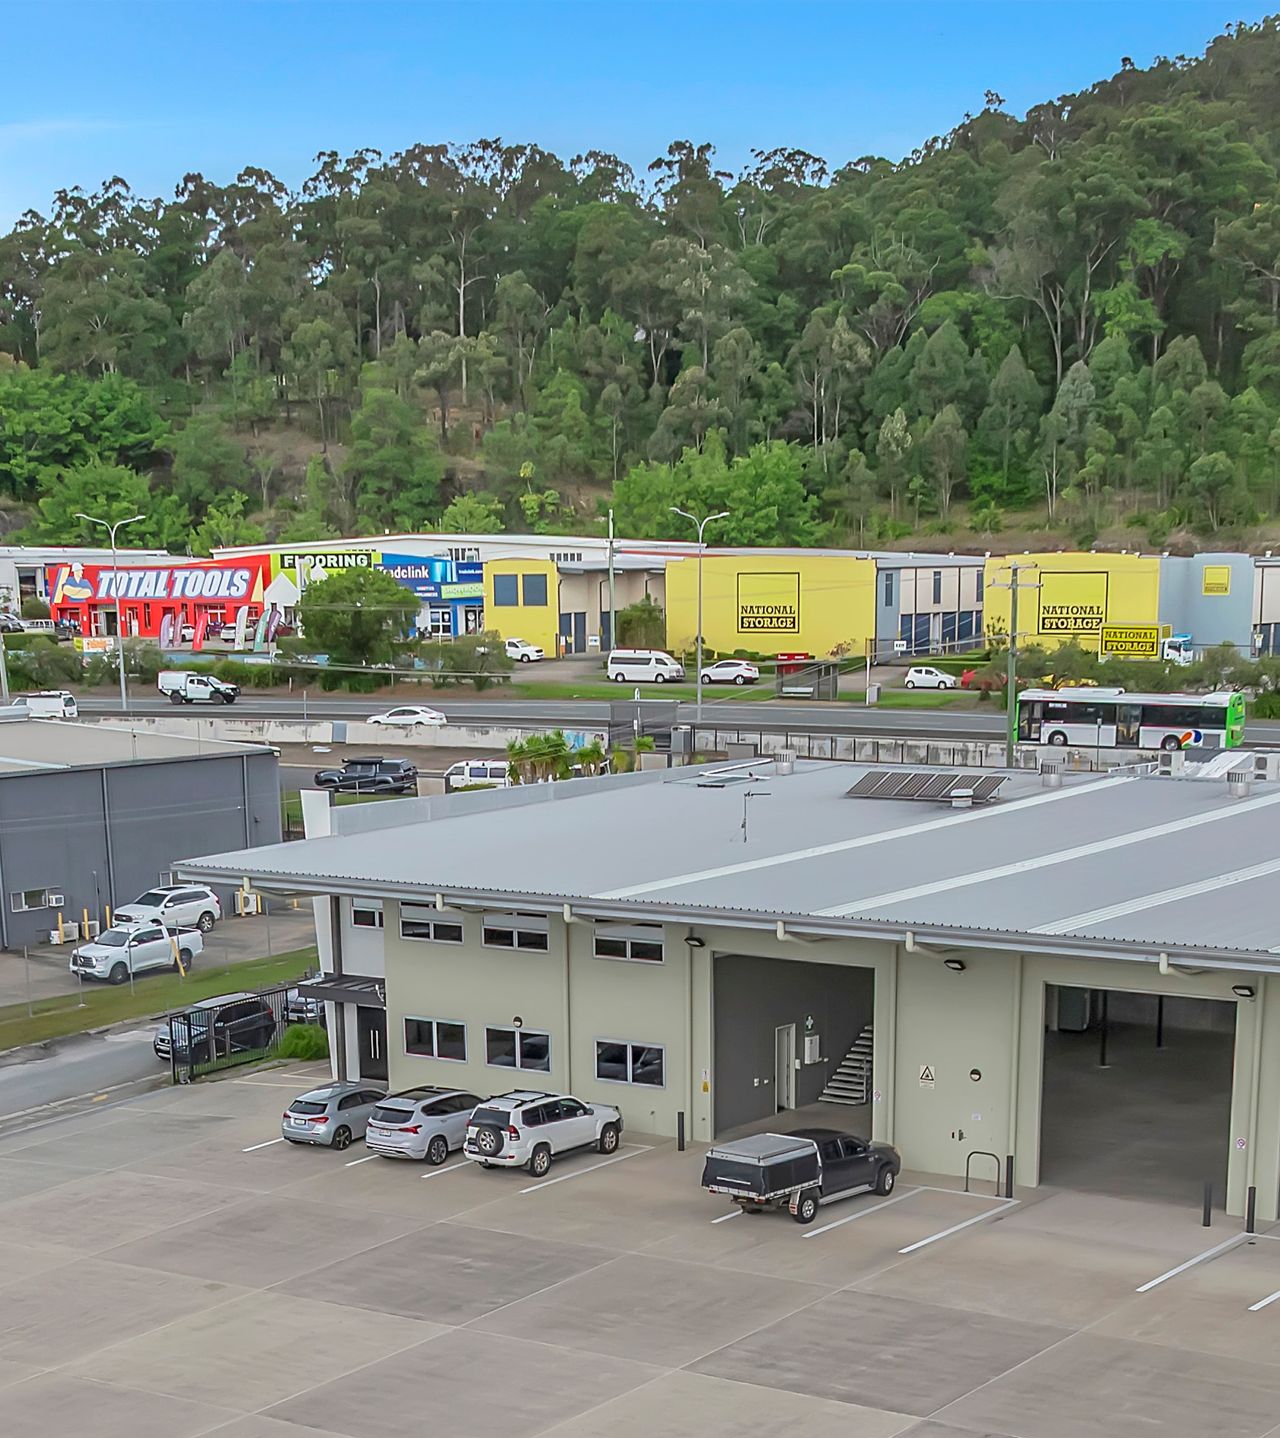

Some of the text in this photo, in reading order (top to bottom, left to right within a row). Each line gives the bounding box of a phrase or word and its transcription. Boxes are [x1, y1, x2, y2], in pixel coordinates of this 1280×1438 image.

[97, 569, 250, 598] TOTAL TOOLS
[741, 605, 796, 614] NATIONAL
[1042, 605, 1103, 615] NATIONAL
[743, 617, 794, 627] STORAGE
[1044, 618, 1100, 629] STORAGE
[1105, 631, 1155, 639] NATIONAL
[1106, 642, 1153, 651] STORAGE
